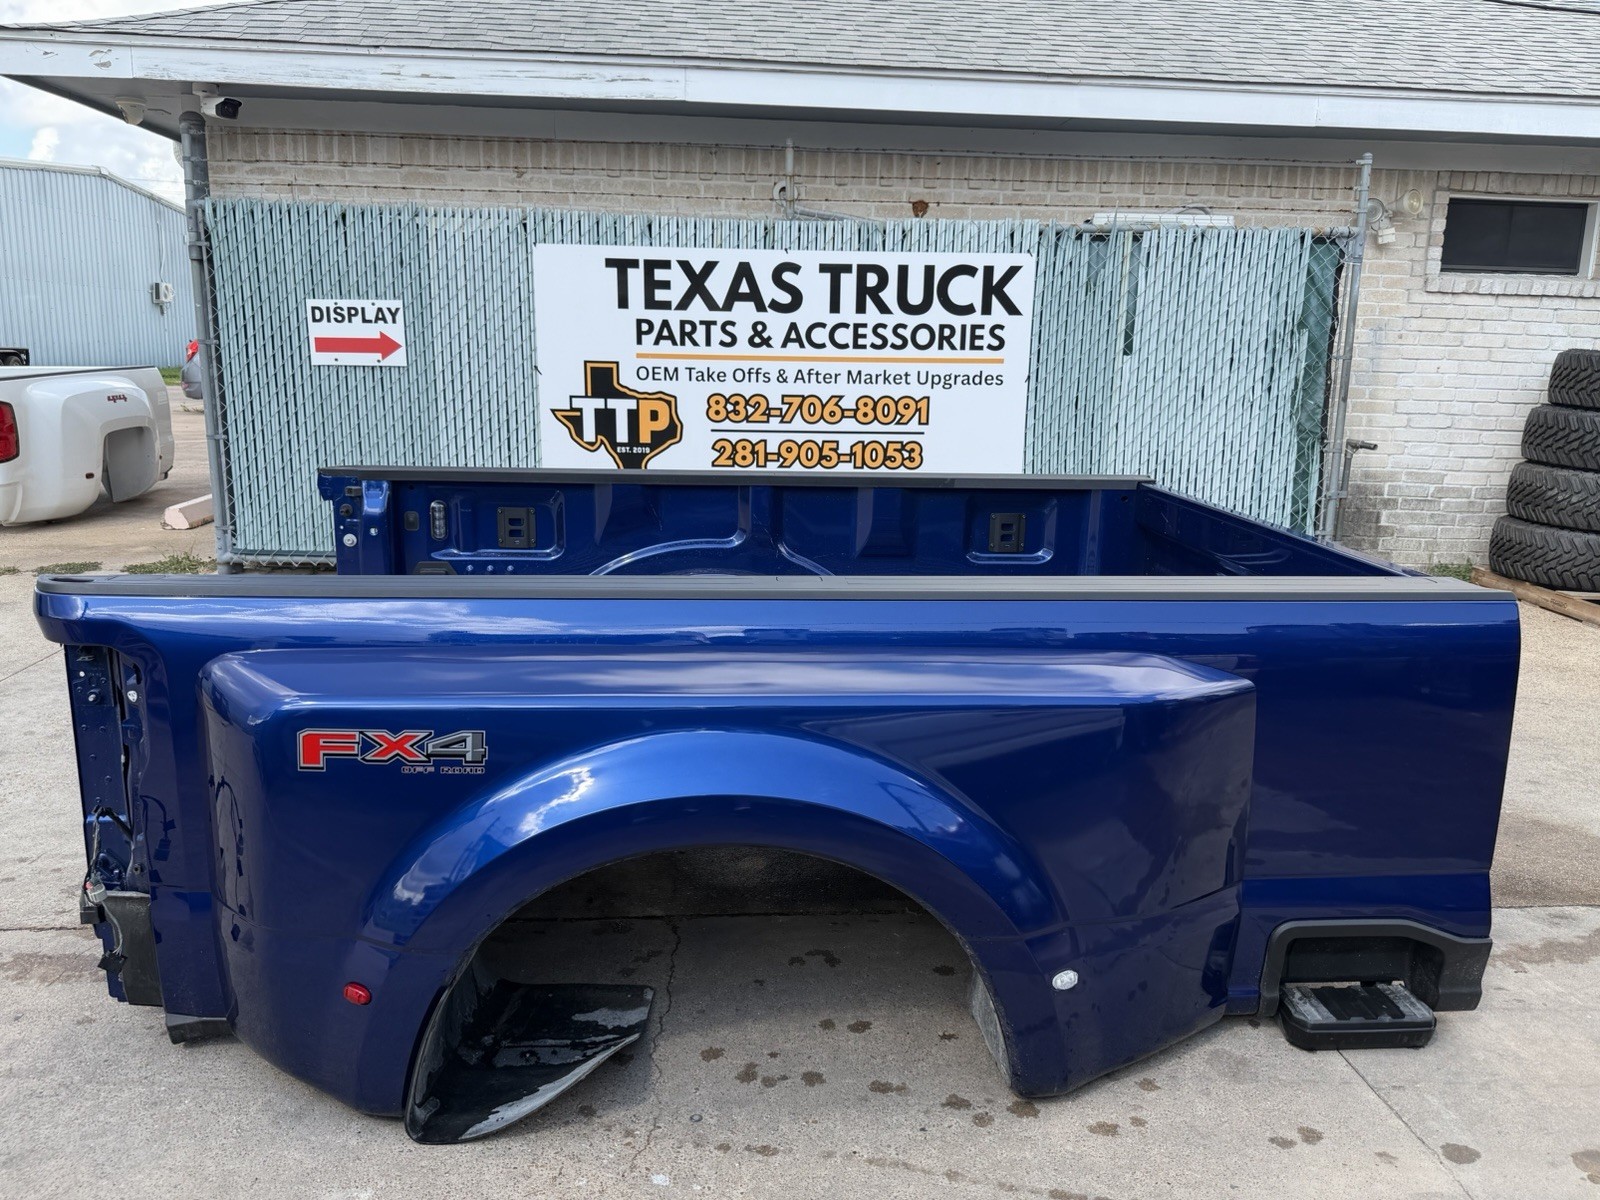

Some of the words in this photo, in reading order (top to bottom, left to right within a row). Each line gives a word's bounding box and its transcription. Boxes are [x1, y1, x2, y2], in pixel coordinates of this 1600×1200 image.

[605, 257, 804, 314] TEXAS
[818, 263, 1024, 316] TRUCK
[310, 305, 401, 325] DISPLAY
[635, 318, 738, 348] PARTS
[747, 320, 774, 349] &
[780, 321, 1006, 351] ACCESSORIES
[635, 365, 680, 382] OEM
[684, 366, 727, 382] Take
[732, 367, 771, 383] Offs
[776, 368, 789, 384] &
[793, 368, 842, 385] After
[846, 369, 911, 386] Market
[916, 370, 1004, 390] Upgrades
[571, 396, 671, 444] TTP
[706, 393, 930, 426] 832-706-8091
[616, 446, 632, 454] EST.
[632, 446, 651, 454] 2019
[711, 438, 923, 470] 281-905-1053
[297, 728, 489, 772] FX4
[401, 766, 435, 775] OFF
[440, 766, 486, 775] ROAD
